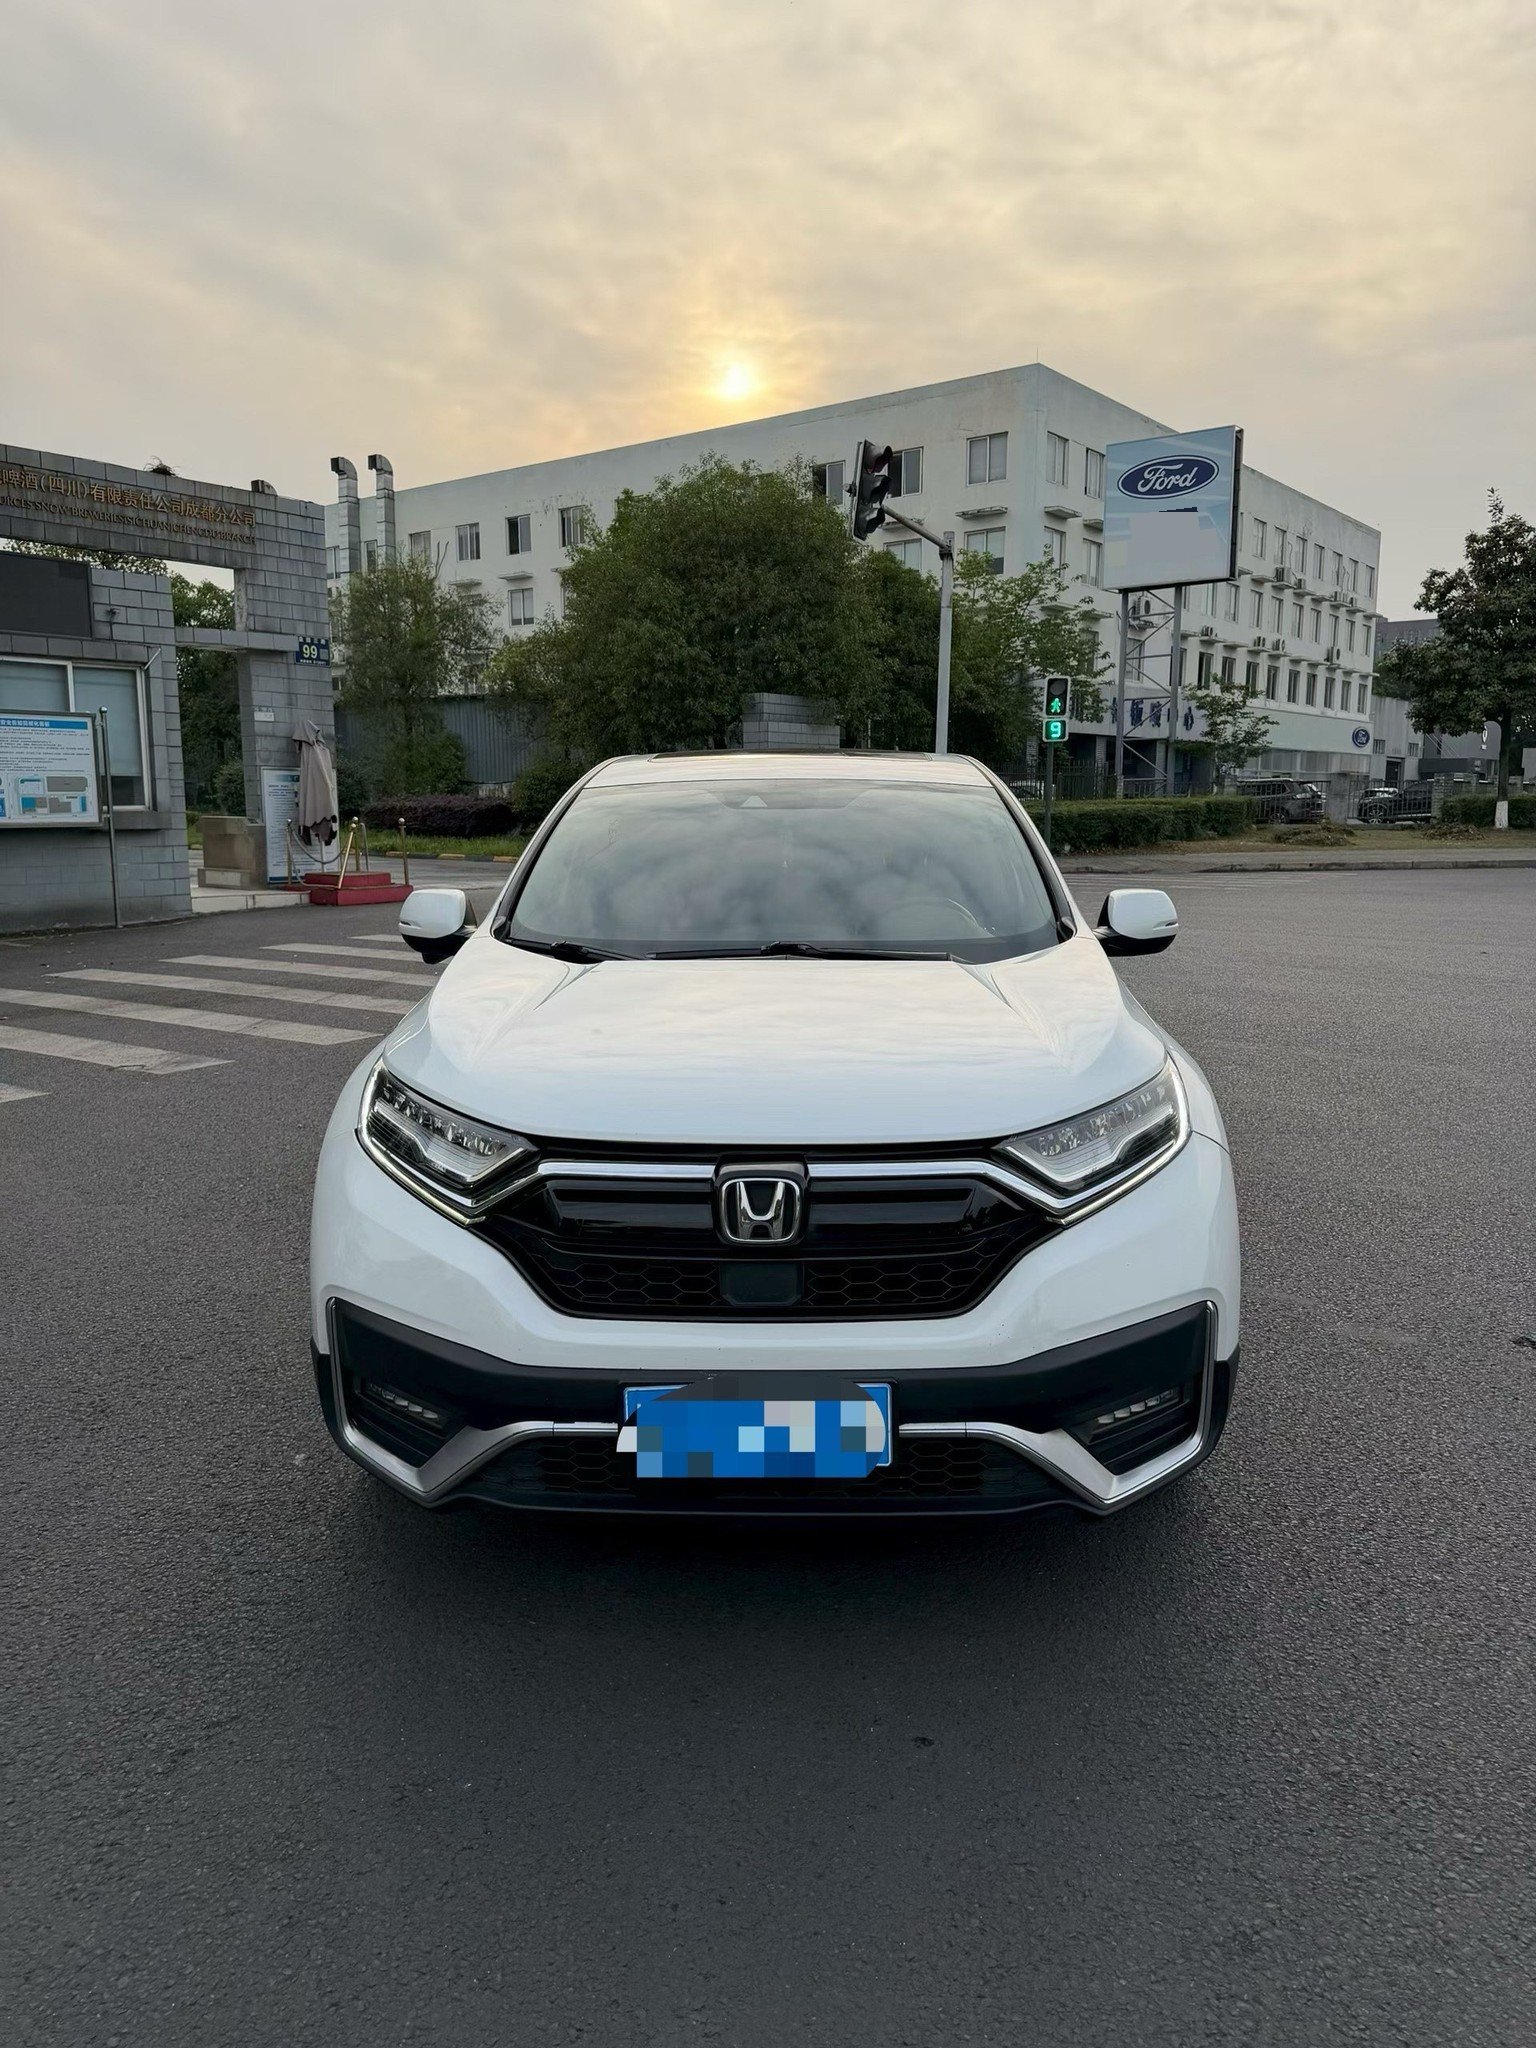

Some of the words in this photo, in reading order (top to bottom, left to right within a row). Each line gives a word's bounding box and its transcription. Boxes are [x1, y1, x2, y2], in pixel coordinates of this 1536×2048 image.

[1137, 463, 1198, 493] Ford
[0, 468, 256, 528] 啤酒(四川)有限责任公司成都分公司
[35, 501, 70, 516] SNOW
[302, 644, 318, 659] 99
[1050, 721, 1062, 738] 9
